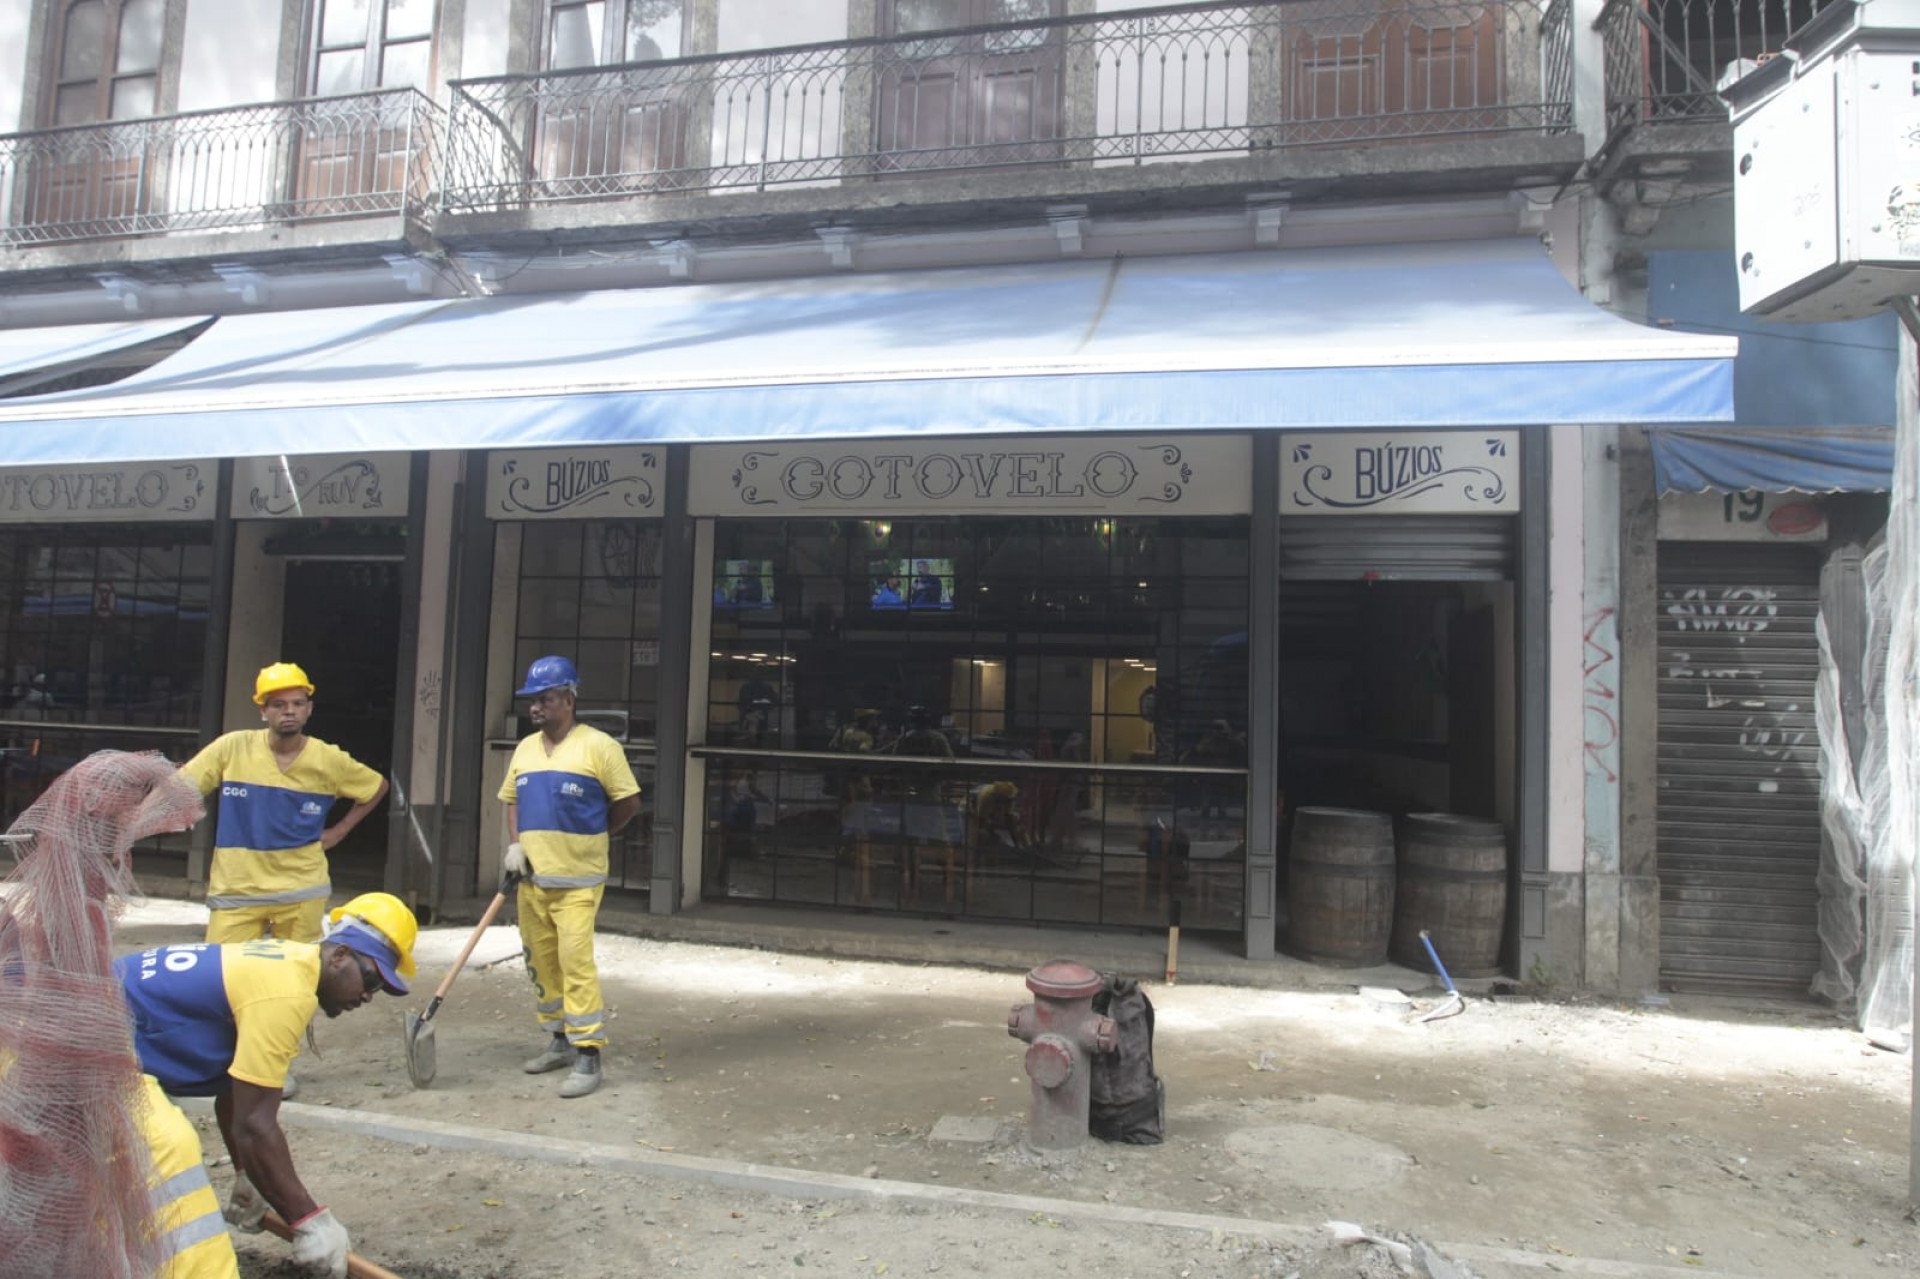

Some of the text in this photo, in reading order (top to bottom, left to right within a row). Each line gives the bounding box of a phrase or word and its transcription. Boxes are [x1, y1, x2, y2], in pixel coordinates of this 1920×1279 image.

[0, 470, 169, 511] TOVELO
[317, 474, 362, 505] RUY
[546, 457, 611, 506] BÚZIOS
[779, 451, 1140, 500] GOTOVELO
[1355, 441, 1443, 500] BÚZIOS
[1723, 491, 1765, 523] 19
[222, 786, 248, 797] CGO
